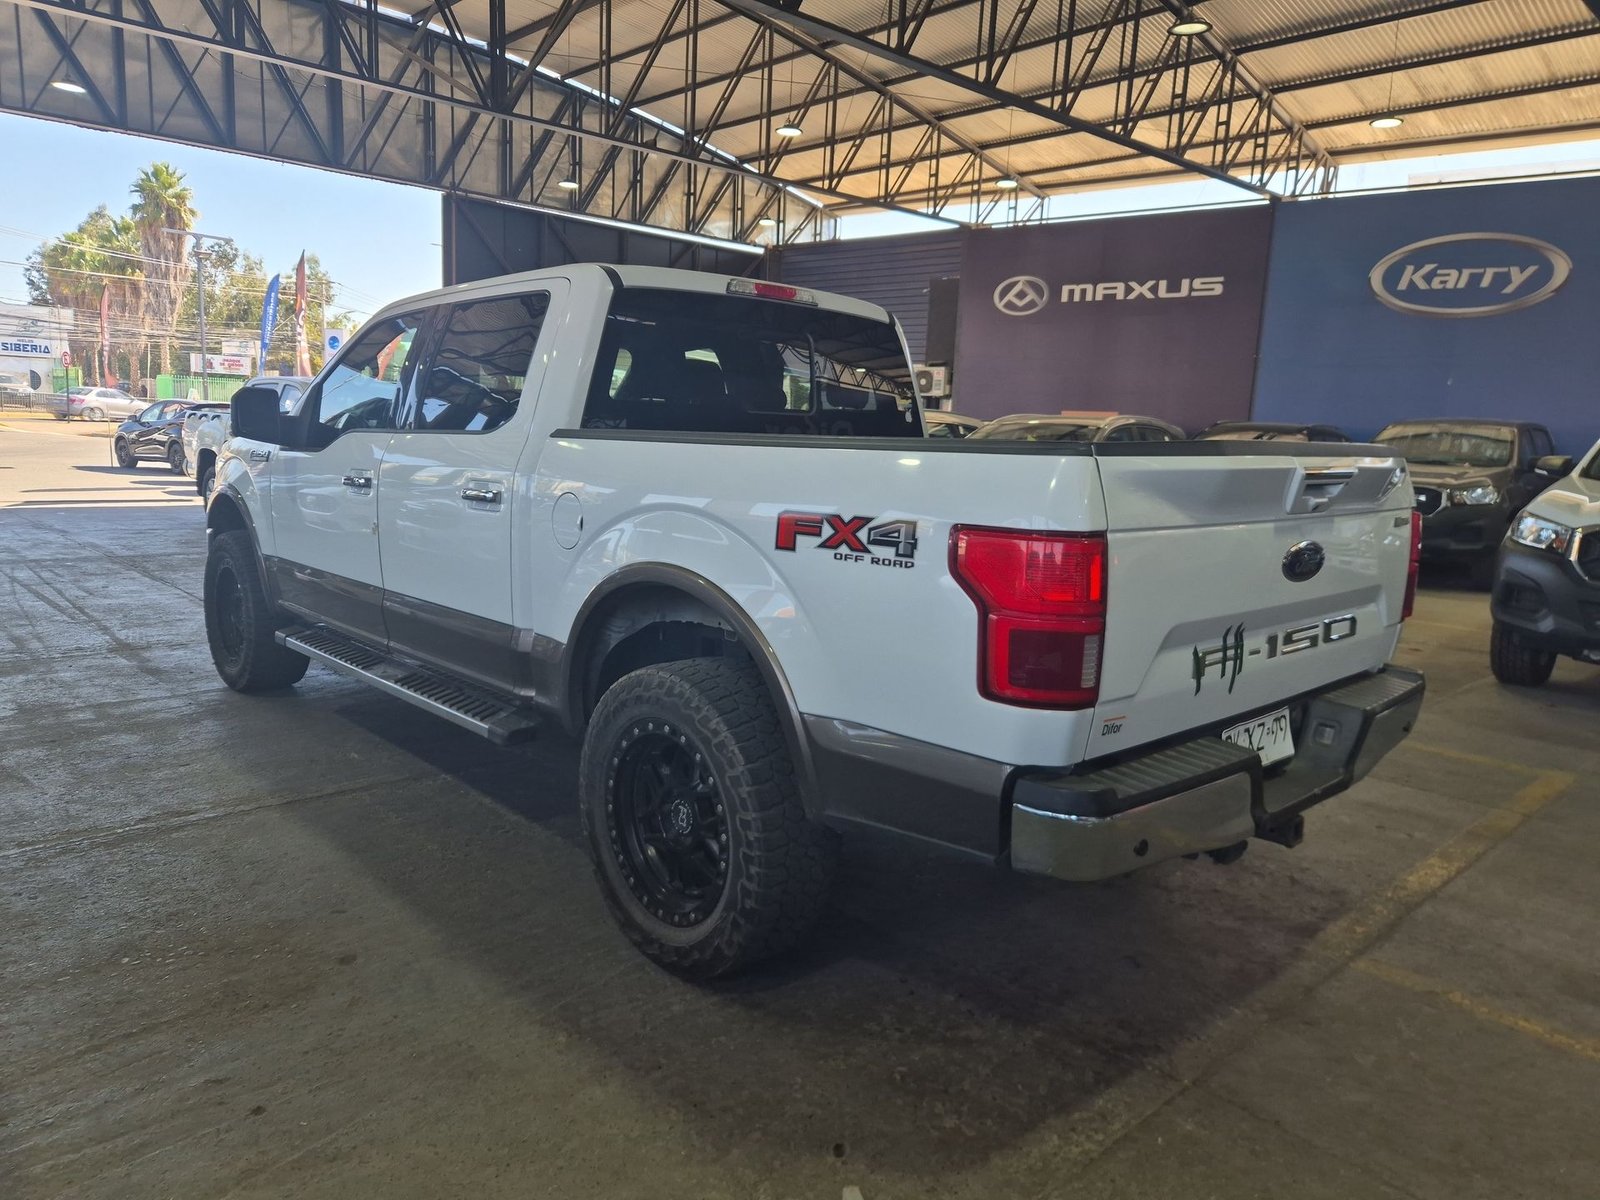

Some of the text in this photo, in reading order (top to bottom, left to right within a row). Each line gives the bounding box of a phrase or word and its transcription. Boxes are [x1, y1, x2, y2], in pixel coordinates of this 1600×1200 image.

[1060, 276, 1225, 303] MAXUS
[1396, 263, 1540, 295] Karry
[1, 342, 51, 354] SIBERIA
[774, 510, 918, 559] FX4
[833, 552, 915, 569] OFF ROAD
[1191, 613, 1358, 681] F-150
[1101, 722, 1124, 736] Difor
